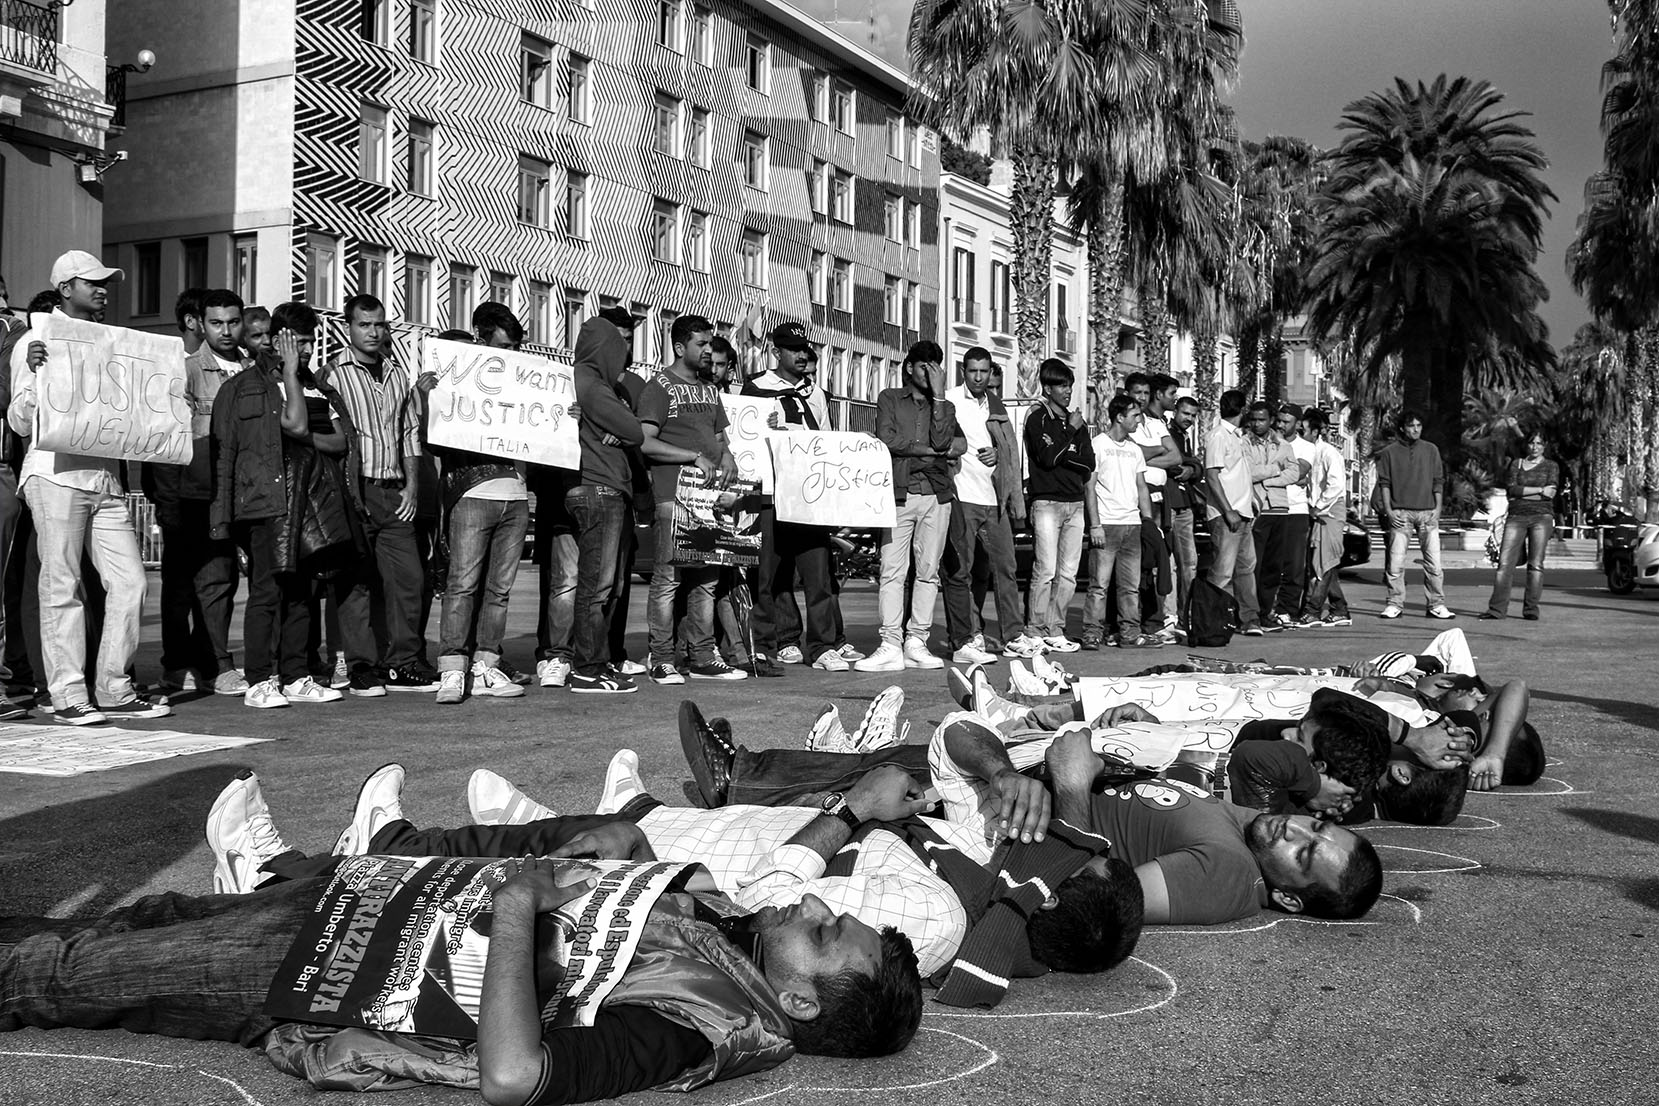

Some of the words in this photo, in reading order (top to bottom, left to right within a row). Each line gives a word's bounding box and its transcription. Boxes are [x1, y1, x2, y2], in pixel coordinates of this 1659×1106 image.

[432, 348, 506, 395] We
[788, 436, 828, 456] WE
[840, 440, 883, 453] WANT
[412, 895, 427, 910] all
[418, 876, 456, 938] deportation
[422, 879, 439, 894] for
[309, 858, 416, 1013] ANTIRAZZISTA
[315, 893, 354, 953] Umberto
[393, 913, 419, 962] migrant
[446, 897, 477, 955] immigrés
[570, 887, 618, 957] lavoratori
[609, 908, 632, 928] ed
[293, 965, 320, 993] Bari
[371, 966, 401, 1012] workers
[399, 941, 424, 991] centres
